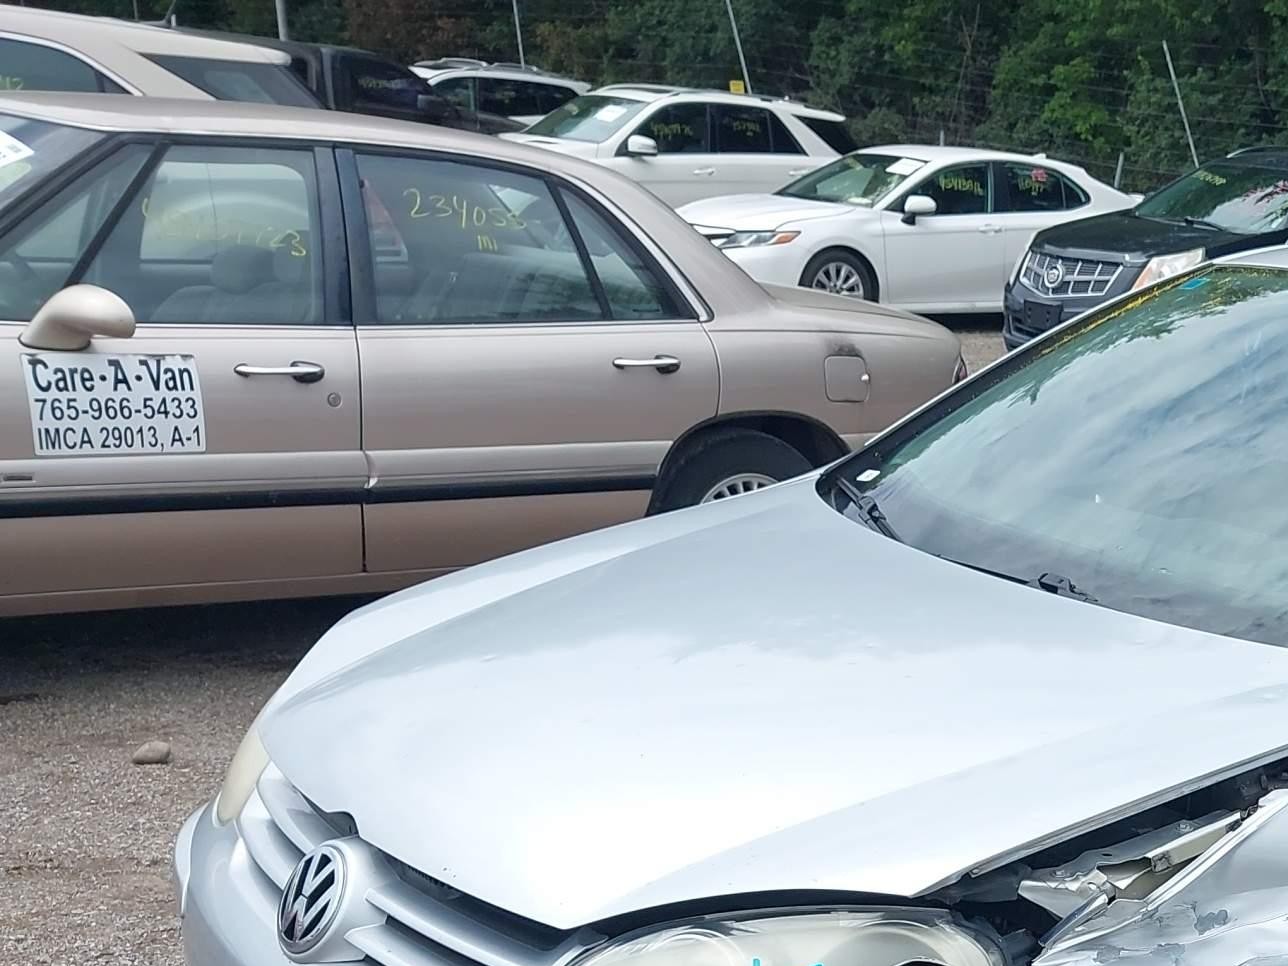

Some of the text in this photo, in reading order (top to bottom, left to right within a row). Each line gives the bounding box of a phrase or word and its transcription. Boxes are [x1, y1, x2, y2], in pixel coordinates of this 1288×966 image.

[33, 396, 198, 422] 765-966-5433
[38, 424, 201, 453] IMCA 29013, A-1
